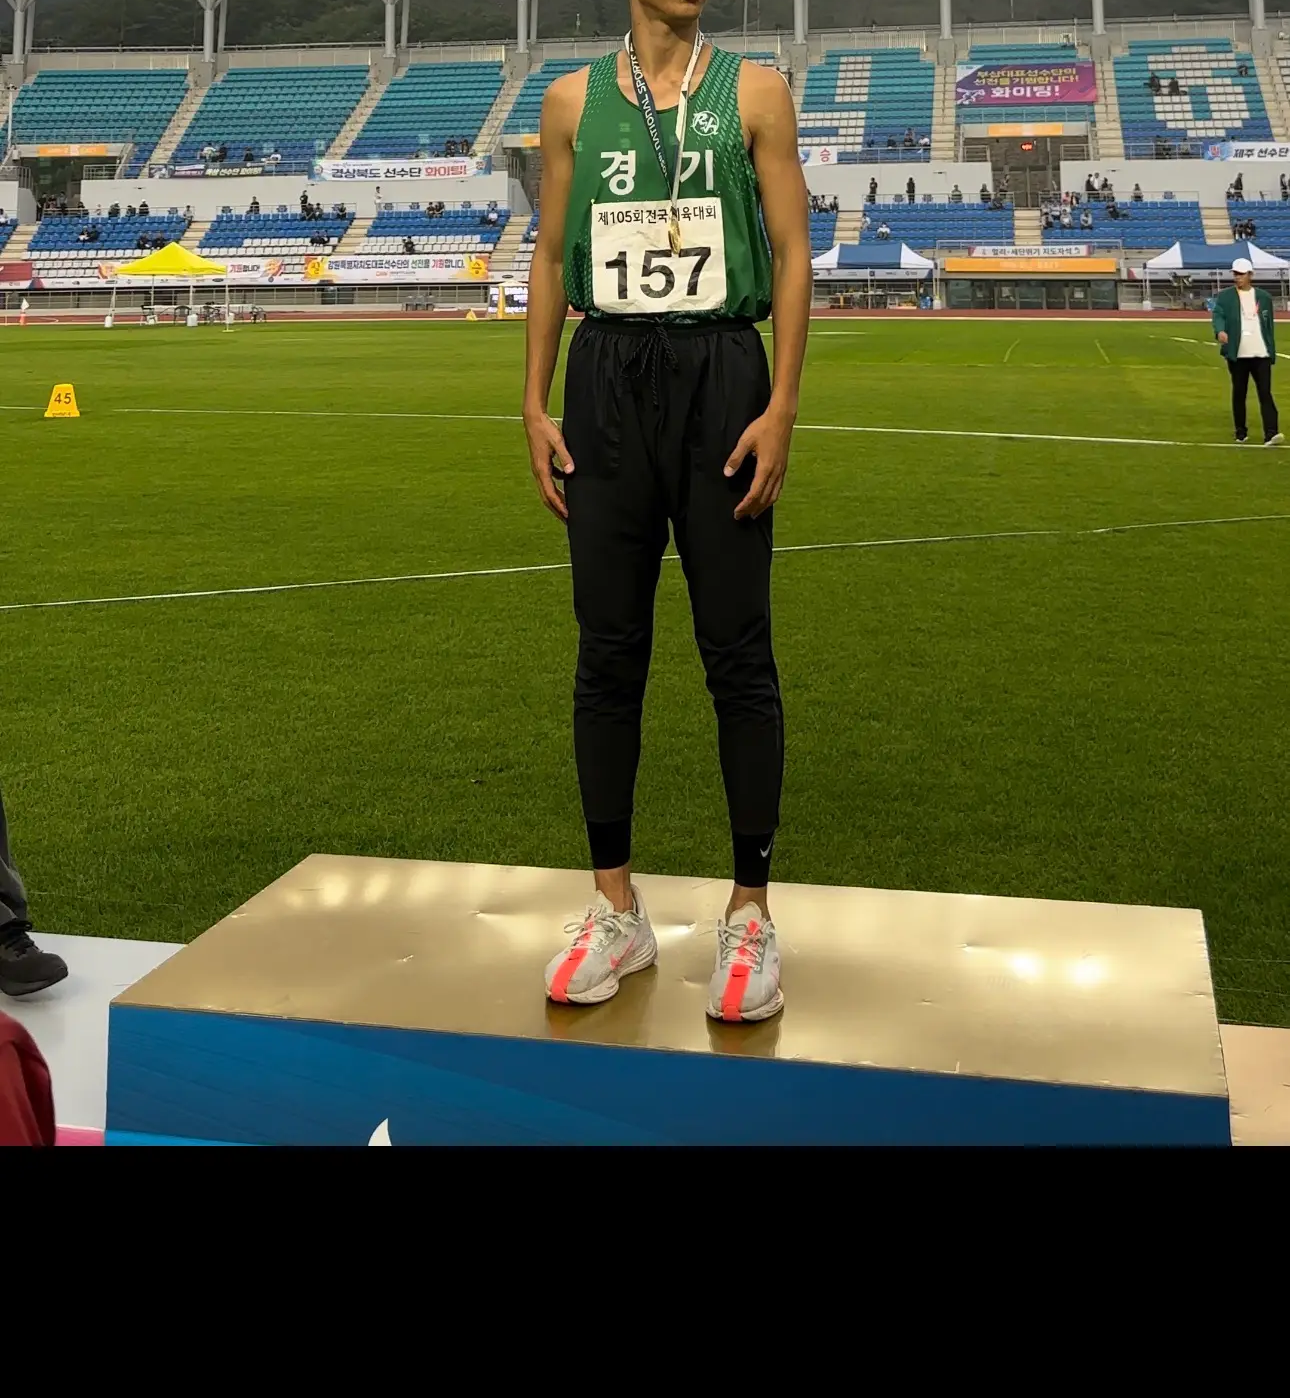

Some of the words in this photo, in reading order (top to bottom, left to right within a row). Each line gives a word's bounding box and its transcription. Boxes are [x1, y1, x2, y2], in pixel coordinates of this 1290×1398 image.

[990, 85, 1060, 98] 화이팅!
[641, 94, 661, 152] NATIONAL
[820, 148, 831, 162] 승
[1233, 148, 1255, 158] 제주
[1257, 147, 1289, 158] 선수단
[331, 168, 381, 178] 경상북도
[383, 167, 422, 178] 선수단
[425, 165, 467, 177] 화이팅!
[605, 247, 711, 299] 157
[54, 392, 72, 405] 45
